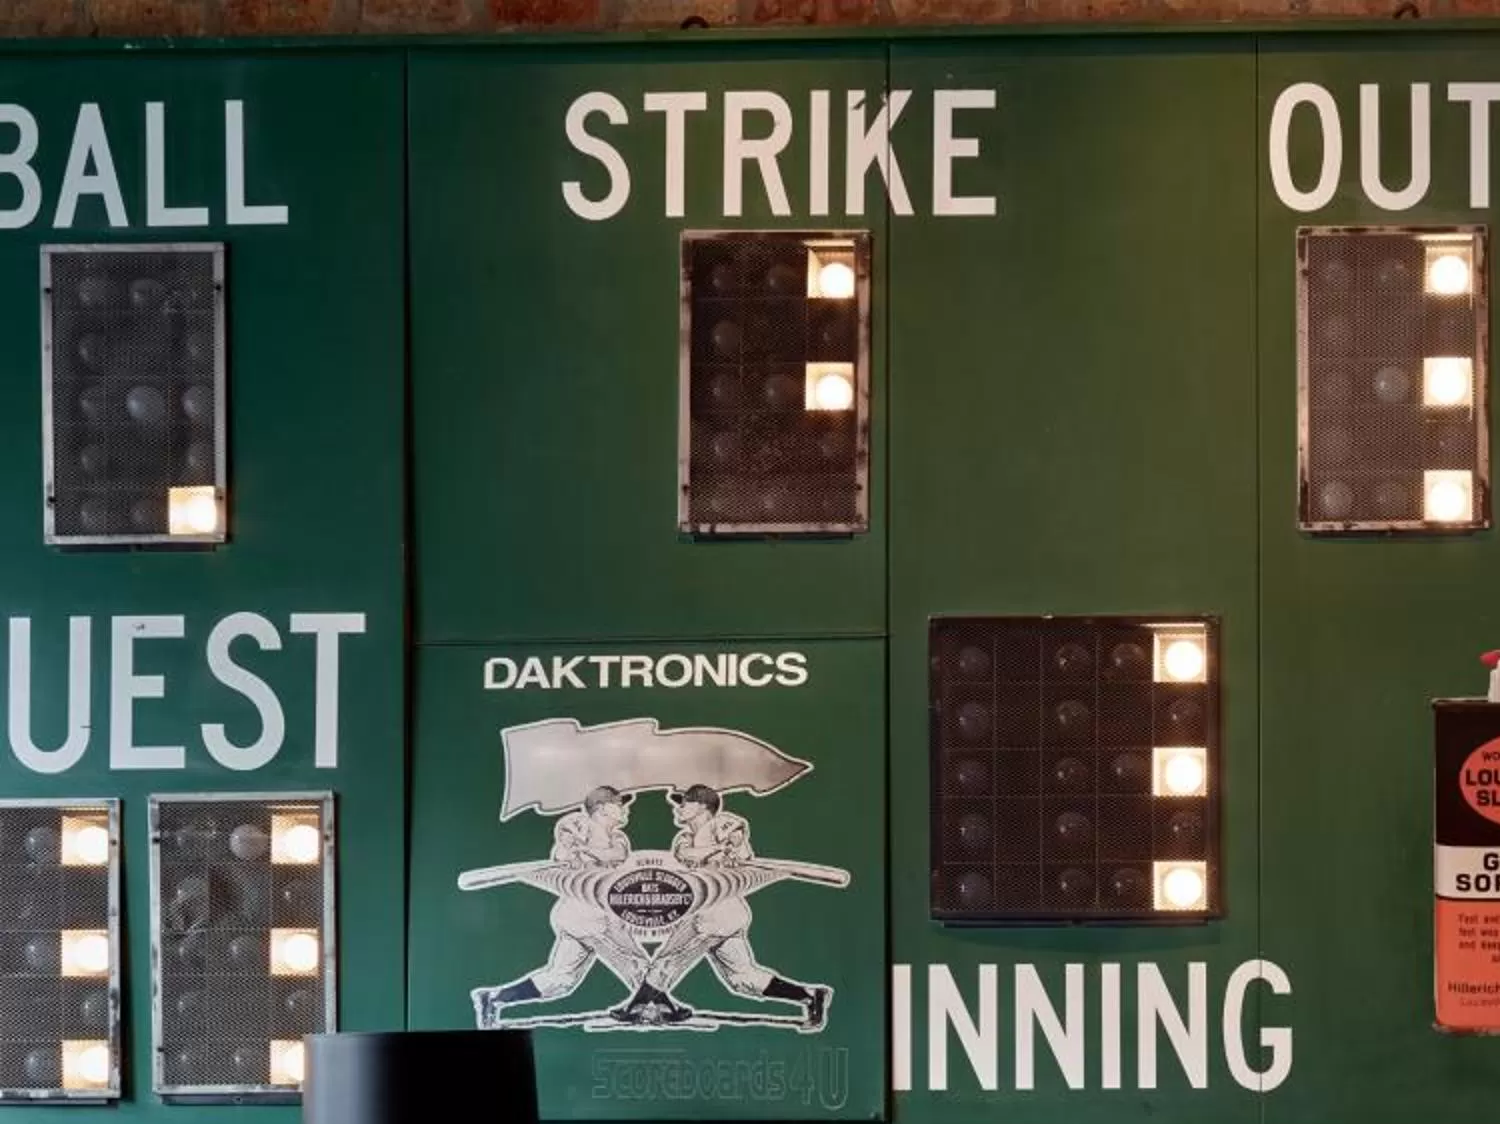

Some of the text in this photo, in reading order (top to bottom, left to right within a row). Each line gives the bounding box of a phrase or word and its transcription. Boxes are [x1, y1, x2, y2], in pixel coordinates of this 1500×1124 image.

[0, 99, 289, 229] BALL
[561, 88, 998, 222] STRIKE
[8, 610, 367, 775] UEST
[483, 651, 810, 690] DAKTRONICS
[892, 958, 1293, 1092] INNING
